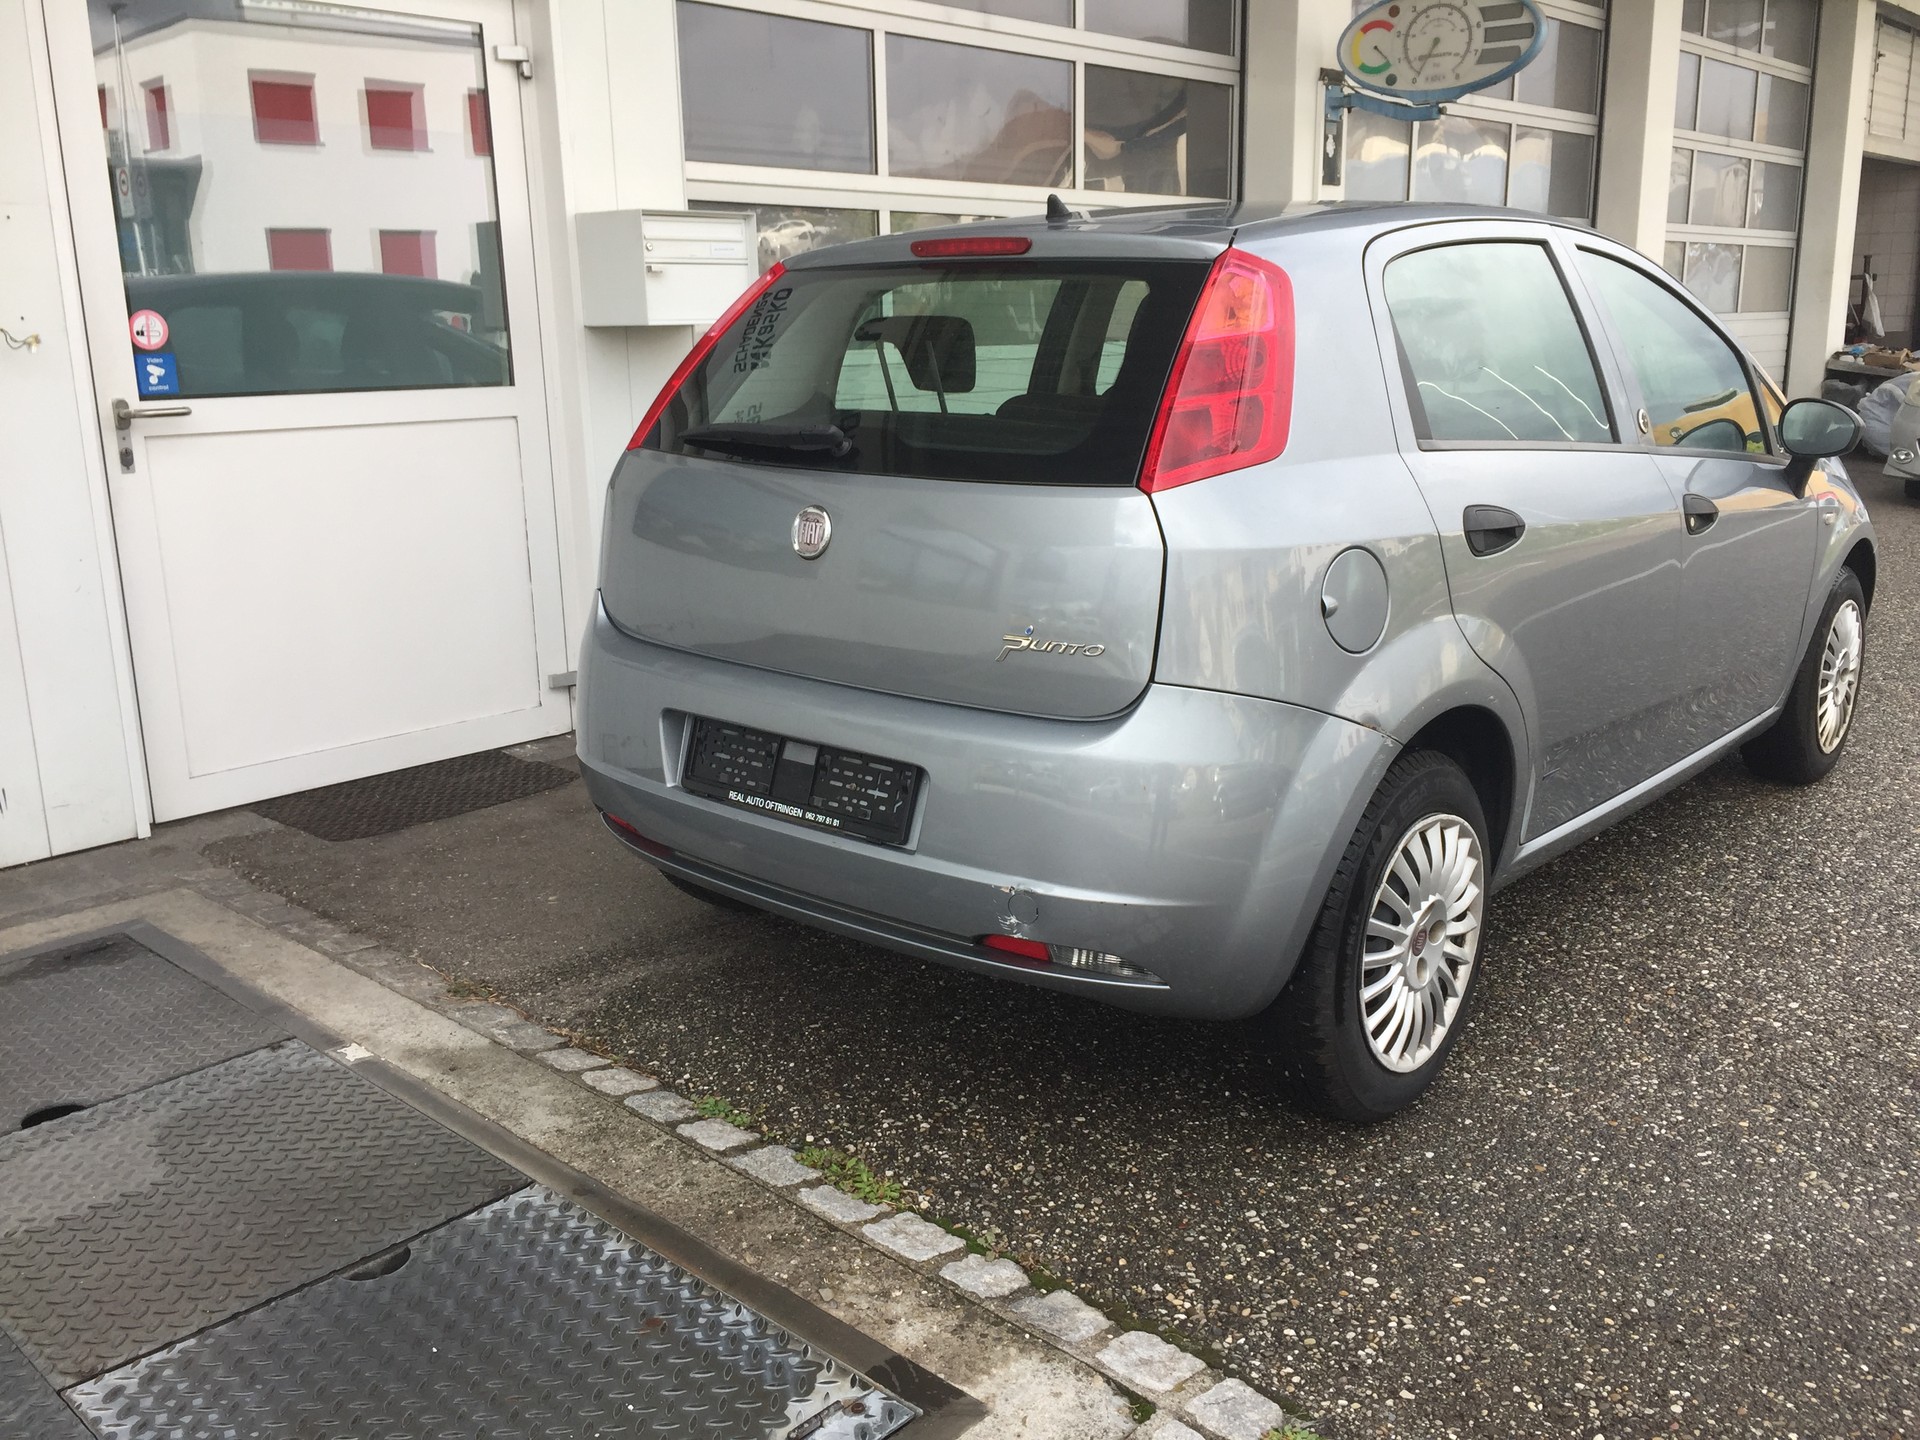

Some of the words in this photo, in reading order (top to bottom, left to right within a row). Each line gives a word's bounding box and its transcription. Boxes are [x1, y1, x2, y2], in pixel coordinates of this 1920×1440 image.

[1476, 21, 1481, 29] 6
[799, 520, 823, 545] FIAT
[728, 790, 745, 803] REAL
[745, 795, 765, 808] AUTO
[764, 800, 804, 818] OFTRINGEN
[805, 811, 816, 820] 062
